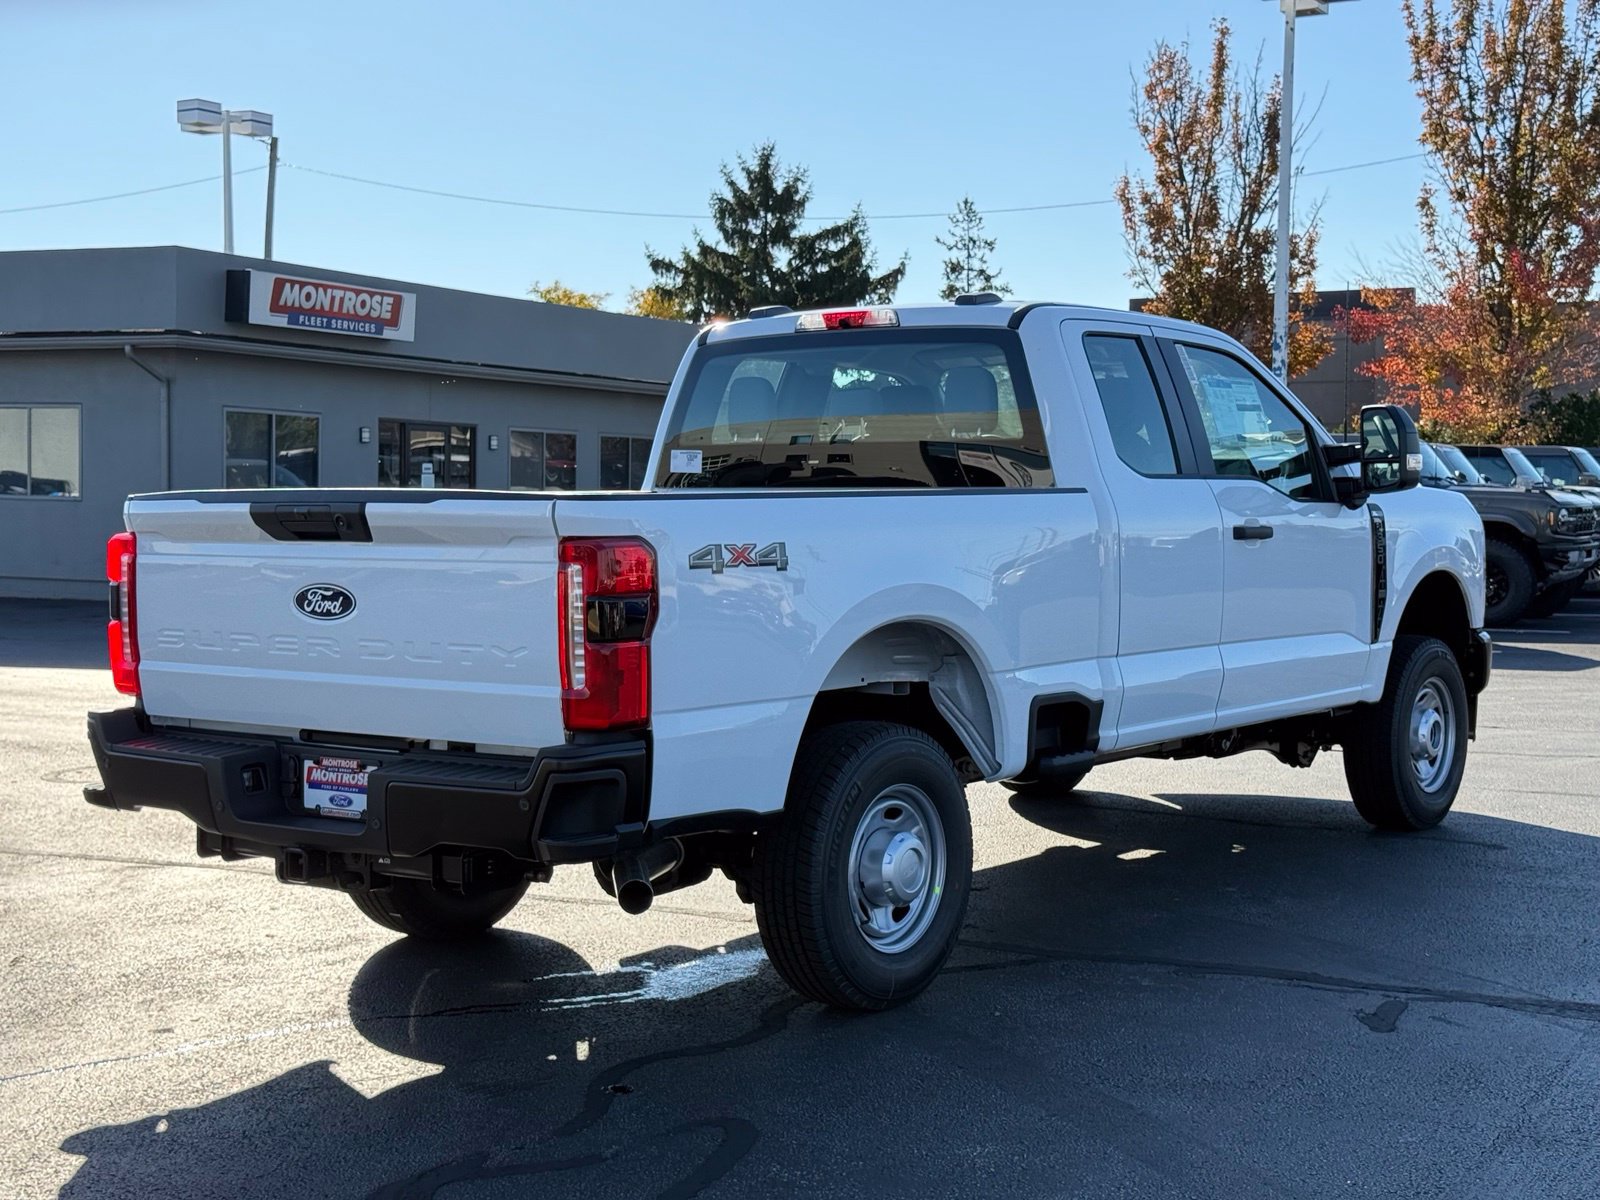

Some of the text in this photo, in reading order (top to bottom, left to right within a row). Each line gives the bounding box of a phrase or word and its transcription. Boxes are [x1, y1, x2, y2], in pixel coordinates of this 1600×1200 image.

[279, 283, 393, 319] MONTROSE
[299, 315, 376, 333] FLEET SERVICES
[303, 588, 344, 615] Ford
[157, 628, 529, 668] SUPER DUTY
[321, 758, 357, 769] MONTROSE
[332, 794, 349, 806] Ford
